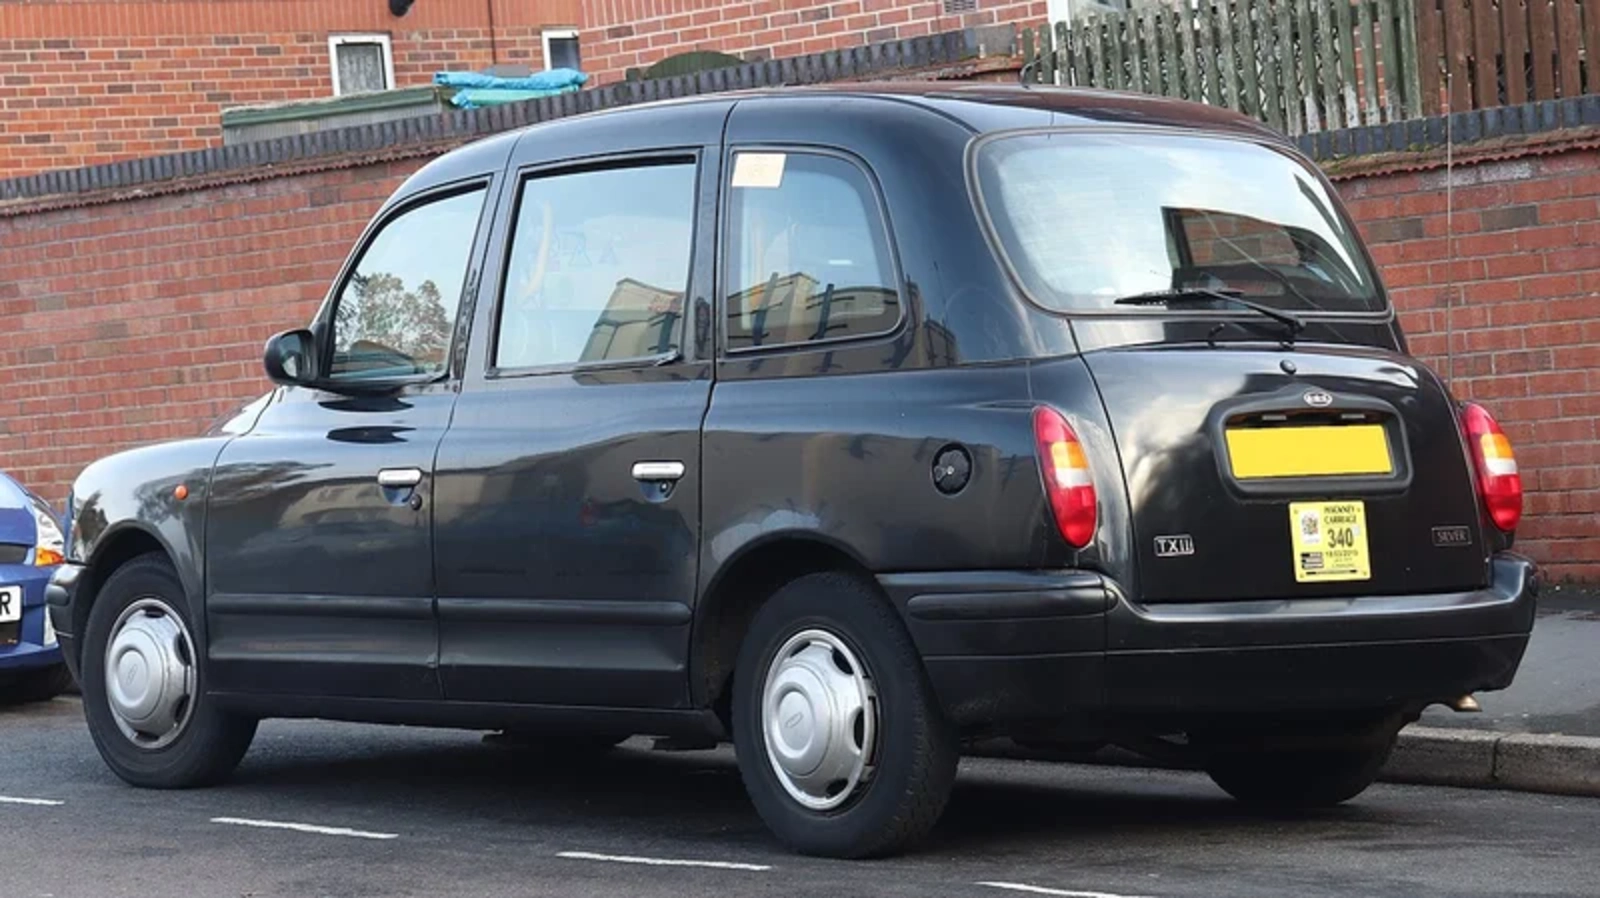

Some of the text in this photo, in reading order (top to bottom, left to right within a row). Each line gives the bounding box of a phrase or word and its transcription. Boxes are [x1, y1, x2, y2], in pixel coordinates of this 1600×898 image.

[1324, 515, 1357, 524] CARRIAGE
[1328, 528, 1354, 548] 340
[0, 591, 11, 616] R
